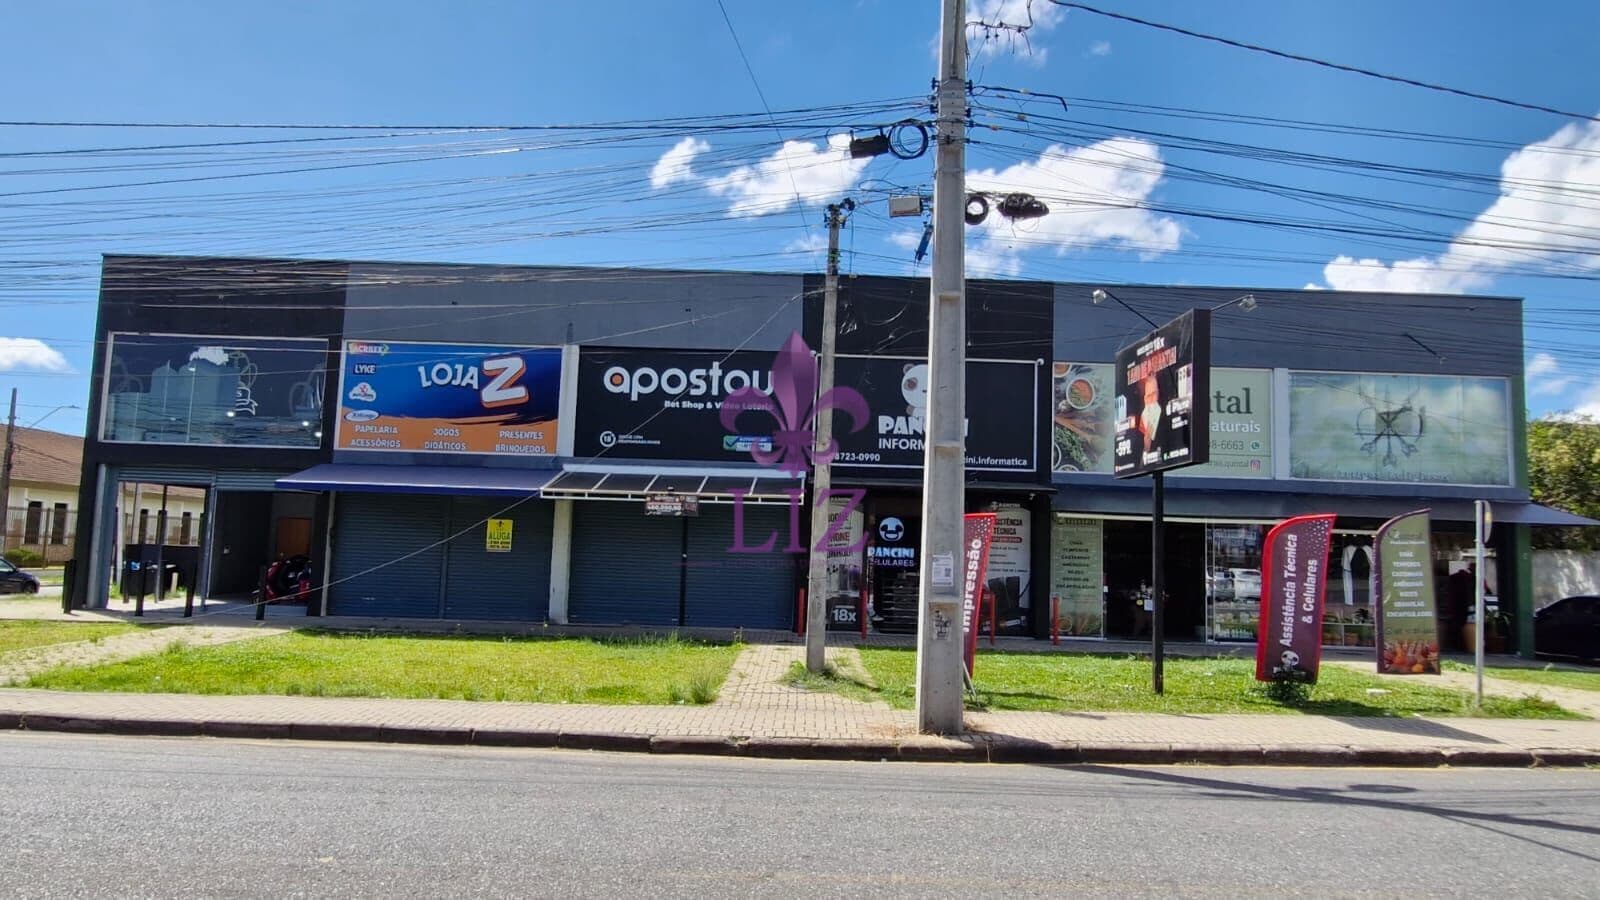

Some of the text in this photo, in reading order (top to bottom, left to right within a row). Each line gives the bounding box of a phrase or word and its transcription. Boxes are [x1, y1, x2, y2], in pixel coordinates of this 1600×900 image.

[355, 364, 376, 374] LYKE
[418, 356, 530, 408] LOJA Z
[603, 361, 775, 401] apostou
[682, 401, 704, 410] Shop
[1209, 387, 1252, 414] tal
[354, 425, 399, 434] PAPELARIA
[878, 415, 969, 437] PANI
[1210, 420, 1260, 432] aturais
[433, 428, 460, 437] JOGOS
[499, 431, 543, 440] PRESENTES
[350, 438, 401, 448] ACESSÓRIOS
[878, 438, 927, 451] INFORM
[1209, 440, 1244, 450] 8-6663
[495, 444, 546, 454] BRINQUEDOS
[833, 452, 881, 462] 8723-0990
[966, 456, 1028, 466] ini.informatica
[488, 531, 511, 540] ALUGA
[868, 547, 915, 558] PANCINI
[1281, 534, 1298, 646] Assistência Técnica
[1302, 559, 1318, 625] & Celulares
[833, 610, 856, 621] 18x
